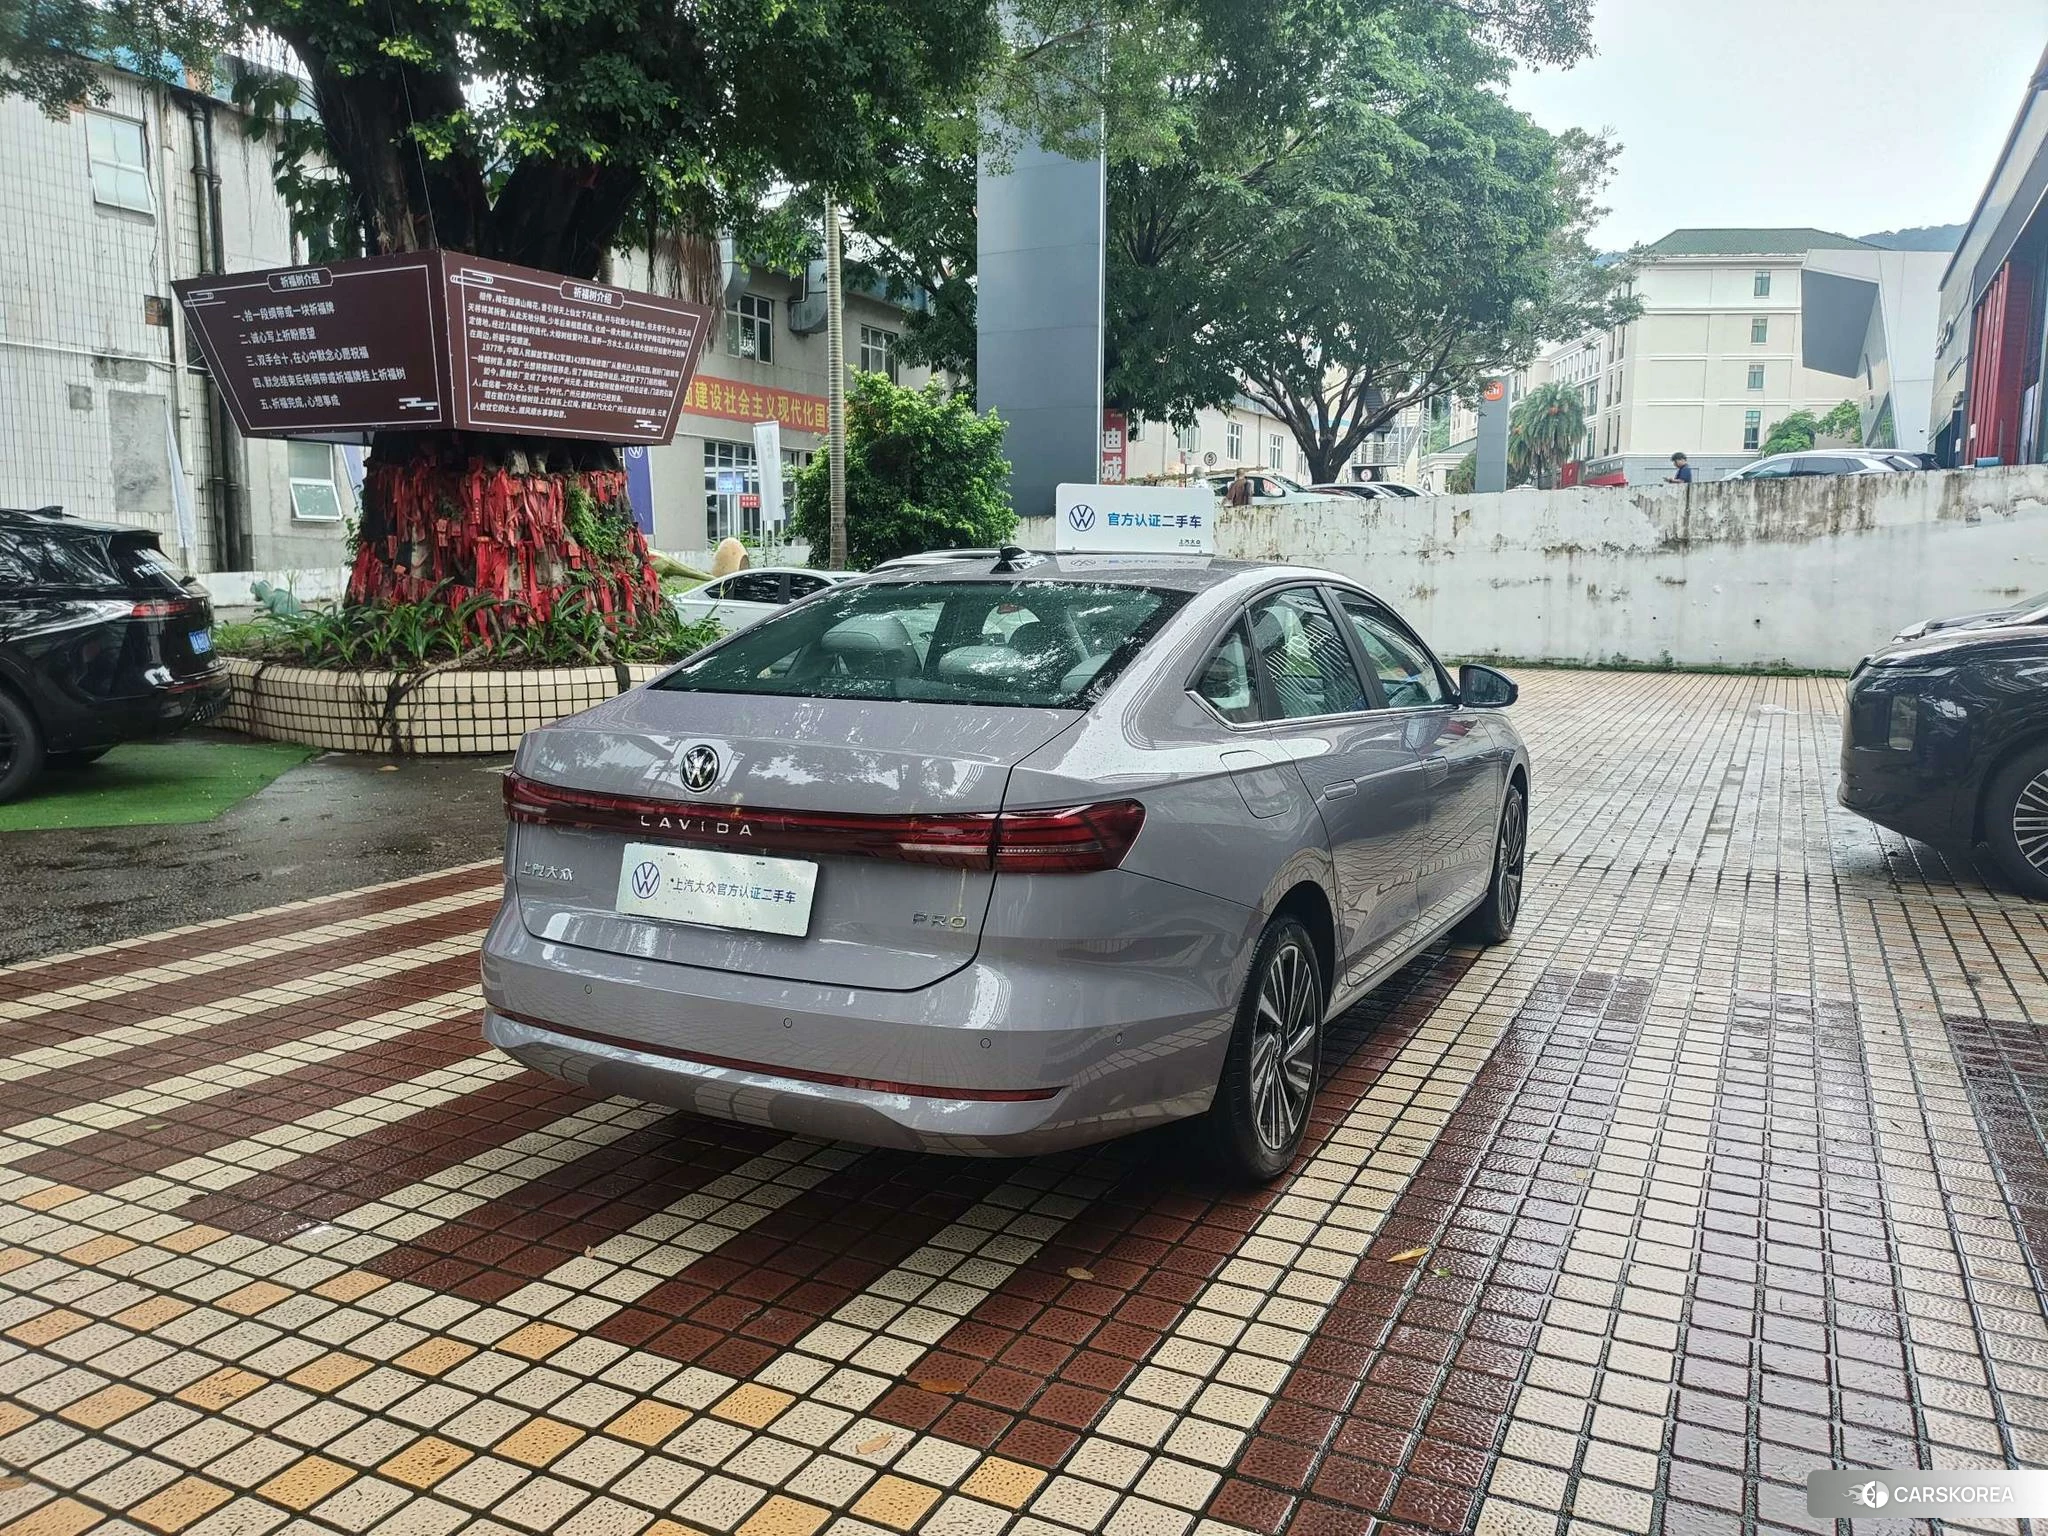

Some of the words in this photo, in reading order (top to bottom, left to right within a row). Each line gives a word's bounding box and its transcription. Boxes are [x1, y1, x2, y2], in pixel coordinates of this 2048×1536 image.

[573, 286, 613, 305] 祈福树介绍
[684, 380, 829, 429] 面建设社会主义现代化国
[1107, 512, 1202, 528] 官方认证二手车
[640, 815, 752, 837] LAVIDA
[520, 861, 574, 881] 上汽大众
[672, 877, 797, 905] 上汽大众官方认证二手车
[912, 913, 967, 929] PRO
